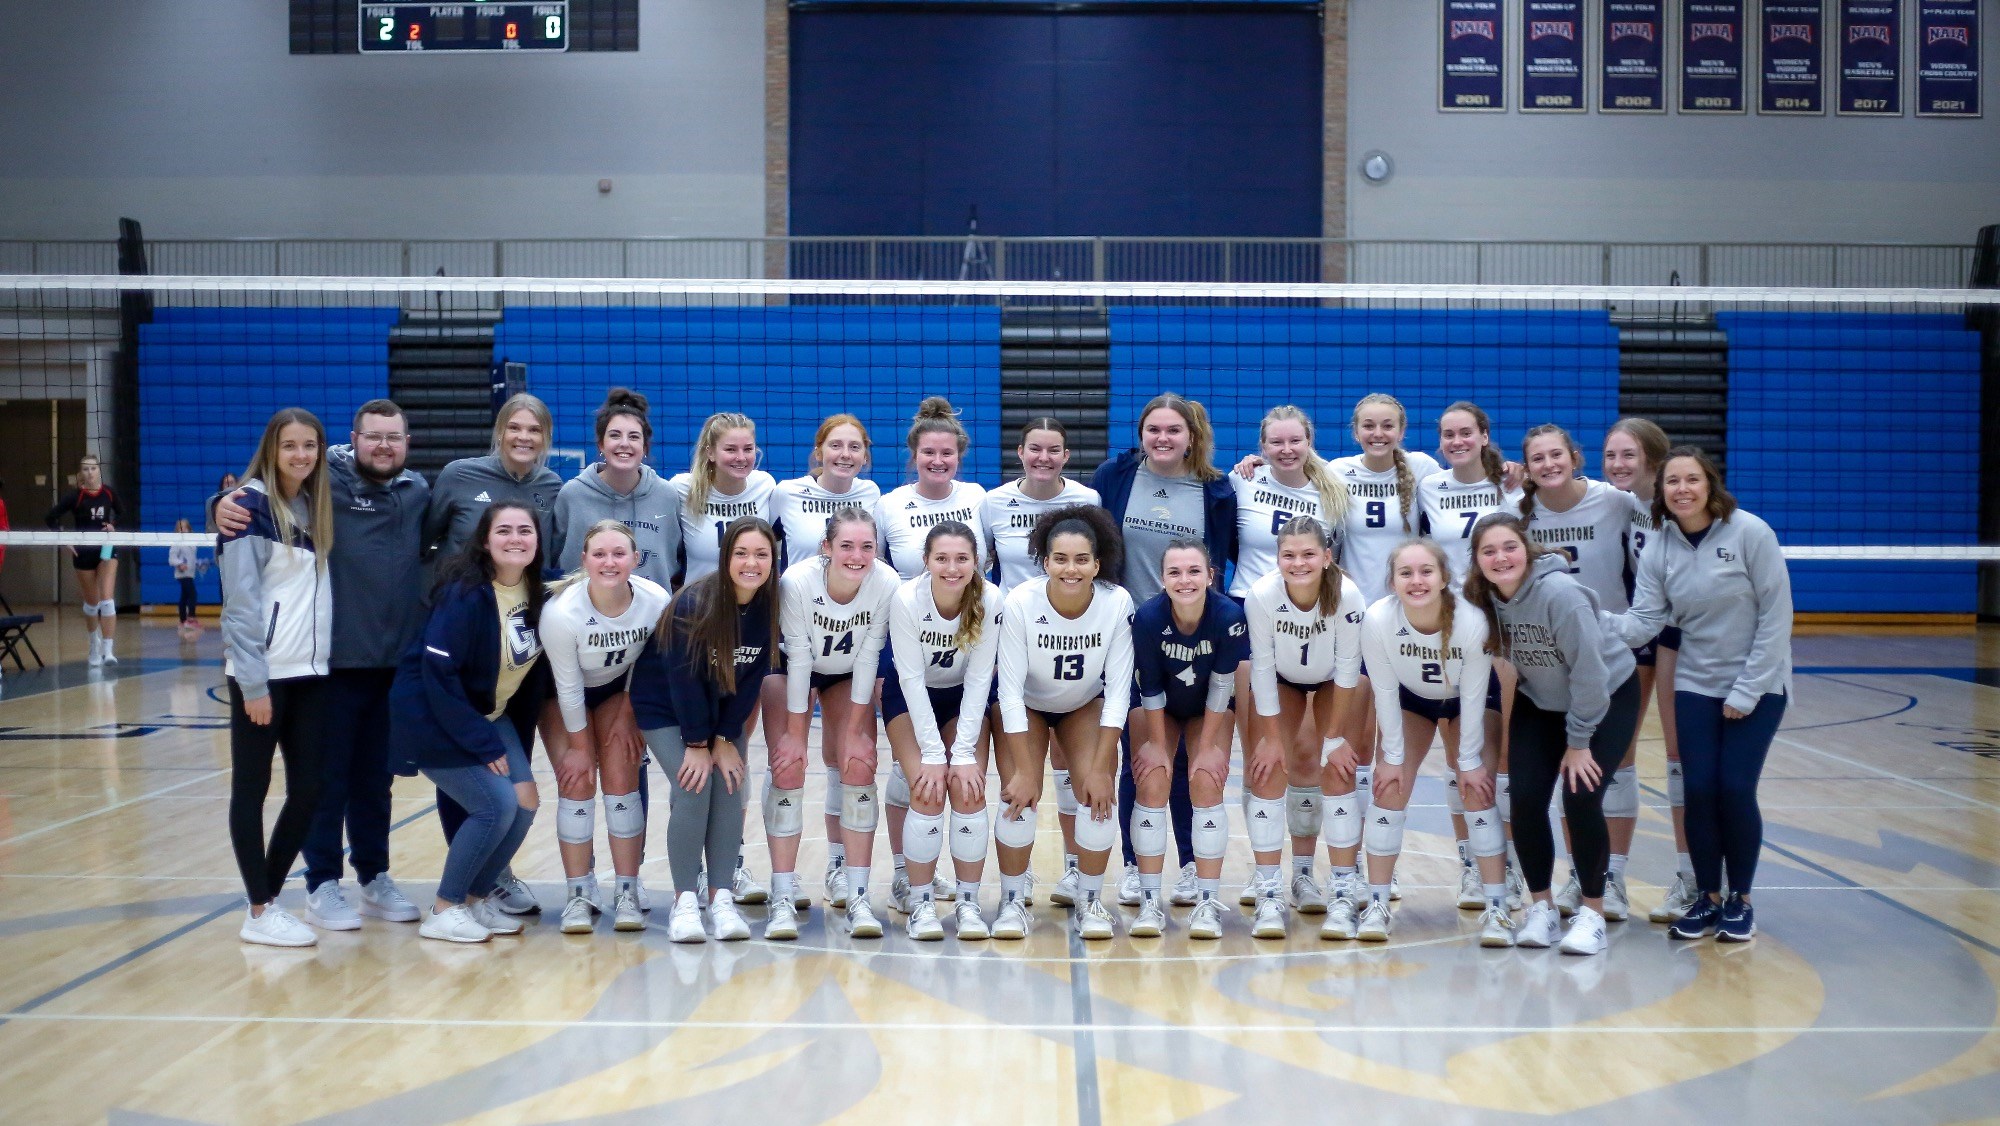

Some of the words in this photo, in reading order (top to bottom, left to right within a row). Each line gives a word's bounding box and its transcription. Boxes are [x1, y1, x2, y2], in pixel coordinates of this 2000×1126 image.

[366, 7, 395, 17] FOULS
[430, 7, 464, 17] PLAYER
[476, 6, 505, 16] FOULS
[533, 6, 561, 16] FOULS
[380, 18, 394, 40] 2
[409, 24, 420, 40] 2
[545, 16, 560, 39] 0
[1453, 21, 1493, 38] NAIA
[1533, 22, 1573, 38] NAIA
[1613, 23, 1652, 39] NAIA
[1693, 24, 1732, 40] NAIA
[1772, 25, 1810, 41] NAIA
[1851, 27, 1889, 43] NAIA
[1929, 28, 1967, 44] NAIA
[1455, 94, 1490, 105] 2001
[1535, 95, 1573, 106] 2002
[1695, 97, 1731, 107] 2003
[1776, 98, 1810, 108] 2014
[1854, 98, 1888, 108] 2017
[1932, 100, 1965, 110] 2021
[704, 502, 758, 517] ORNERSTONE
[1254, 490, 1317, 516] CORNERSTONE
[90, 506, 105, 520] 14
[1366, 501, 1386, 528] 9
[1460, 512, 1479, 539] 7
[1531, 525, 1594, 543] CORNERSTONE
[813, 611, 871, 632] CORNERSTONE
[588, 626, 648, 648] CORNERSTONE
[822, 631, 854, 656] 14
[1037, 632, 1102, 651] CORNERSTONE
[604, 648, 627, 667] 11
[1300, 642, 1310, 666] 1
[1053, 654, 1085, 681] 13
[1175, 664, 1197, 686] 4
[1422, 663, 1443, 683] 2
